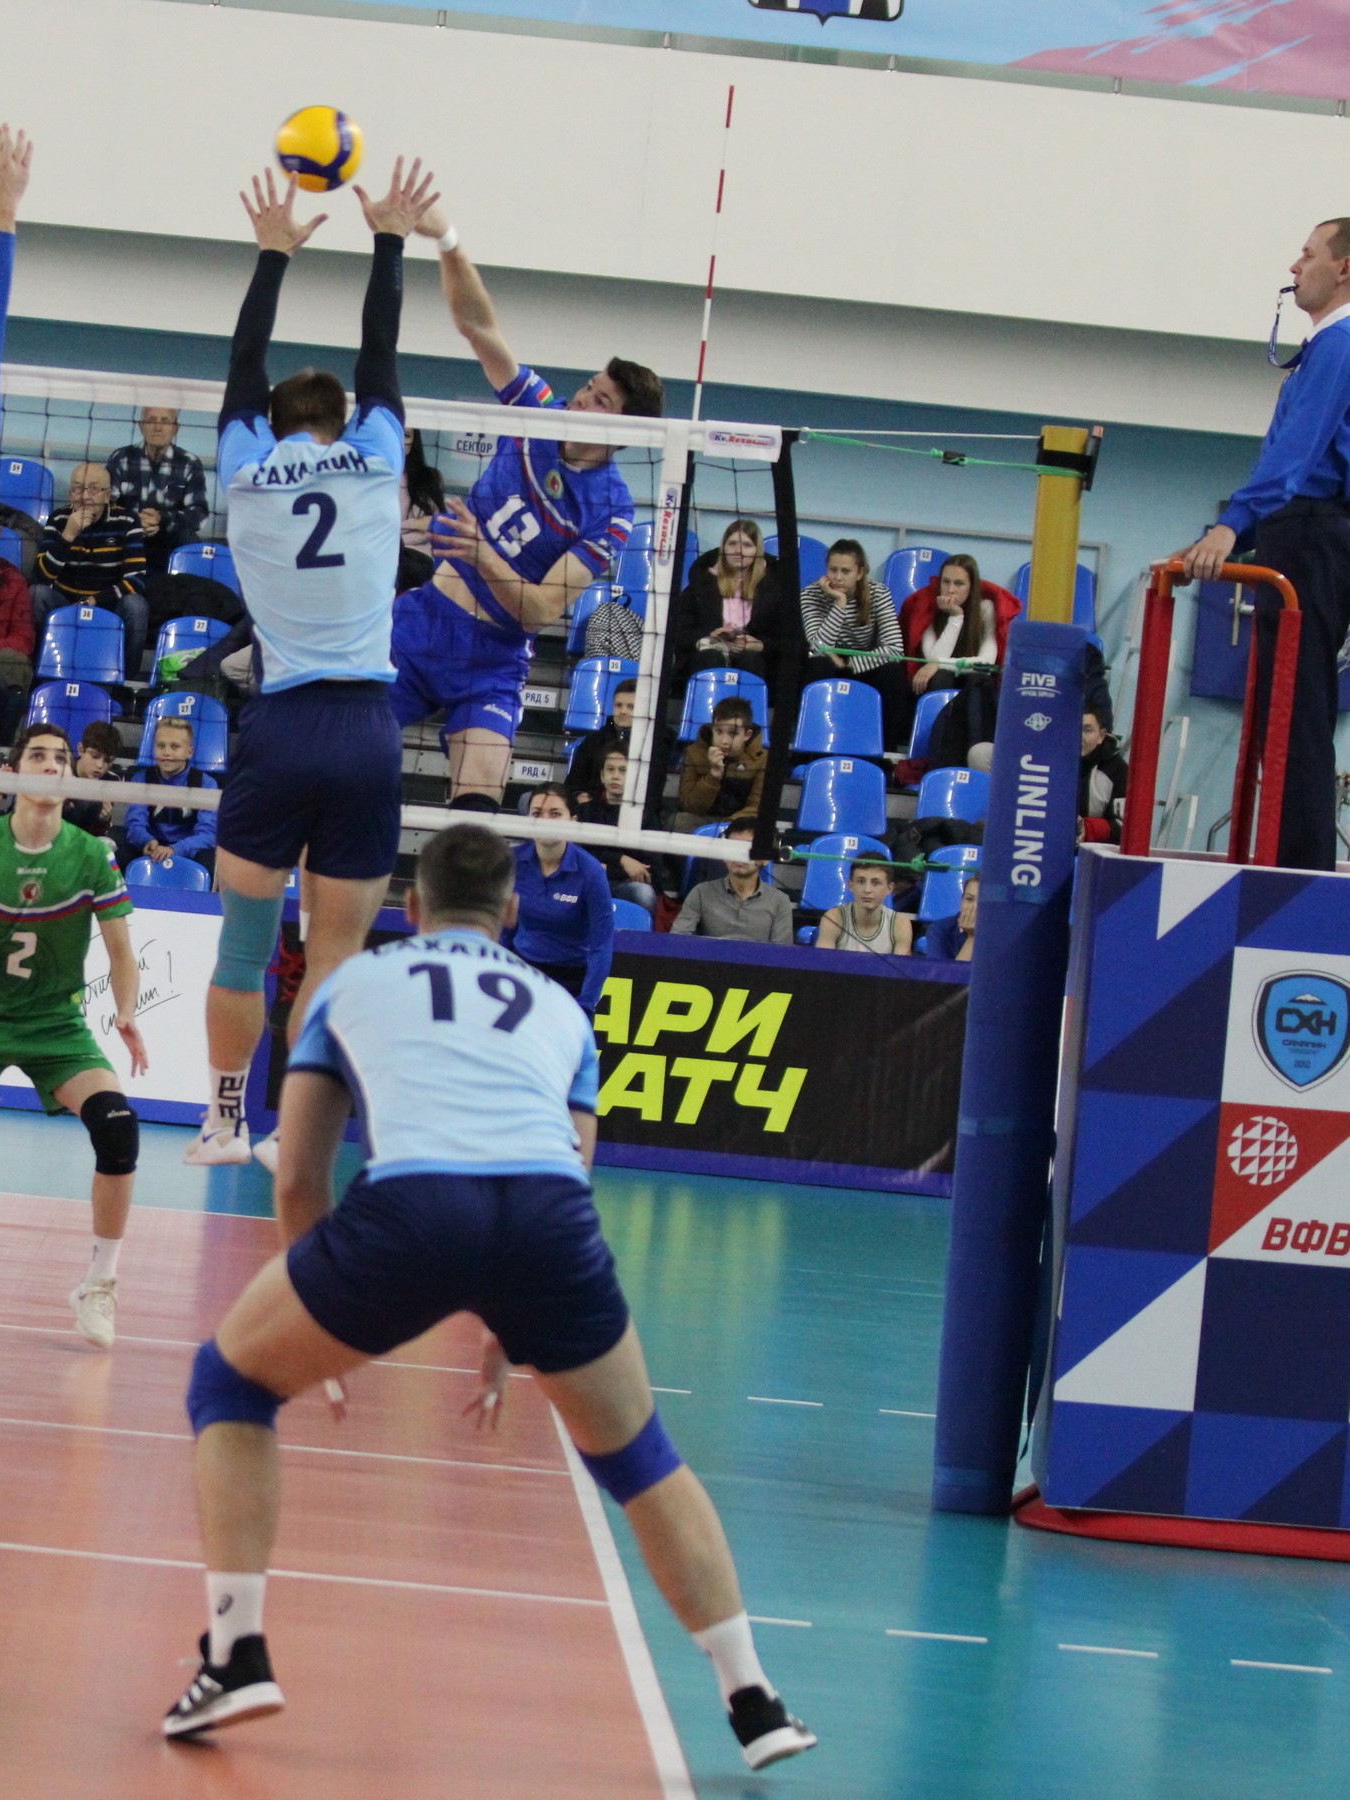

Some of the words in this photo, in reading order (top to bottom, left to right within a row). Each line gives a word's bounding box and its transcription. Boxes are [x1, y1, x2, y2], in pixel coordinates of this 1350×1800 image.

[12, 464, 20, 472] 59
[457, 440, 493, 453] СЕКТОР
[292, 492, 345, 569] 2
[525, 692, 542, 704] РЯД
[544, 694, 550, 704] 5
[521, 766, 539, 777] РЯД
[540, 768, 547, 777] 4
[1011, 754, 1050, 888] JINLING
[6, 932, 37, 979] 2
[408, 960, 536, 1034] 19
[594, 977, 793, 1058] АРИ
[596, 1050, 808, 1132] АТЧ
[1261, 1217, 1350, 1257] ВФВ
